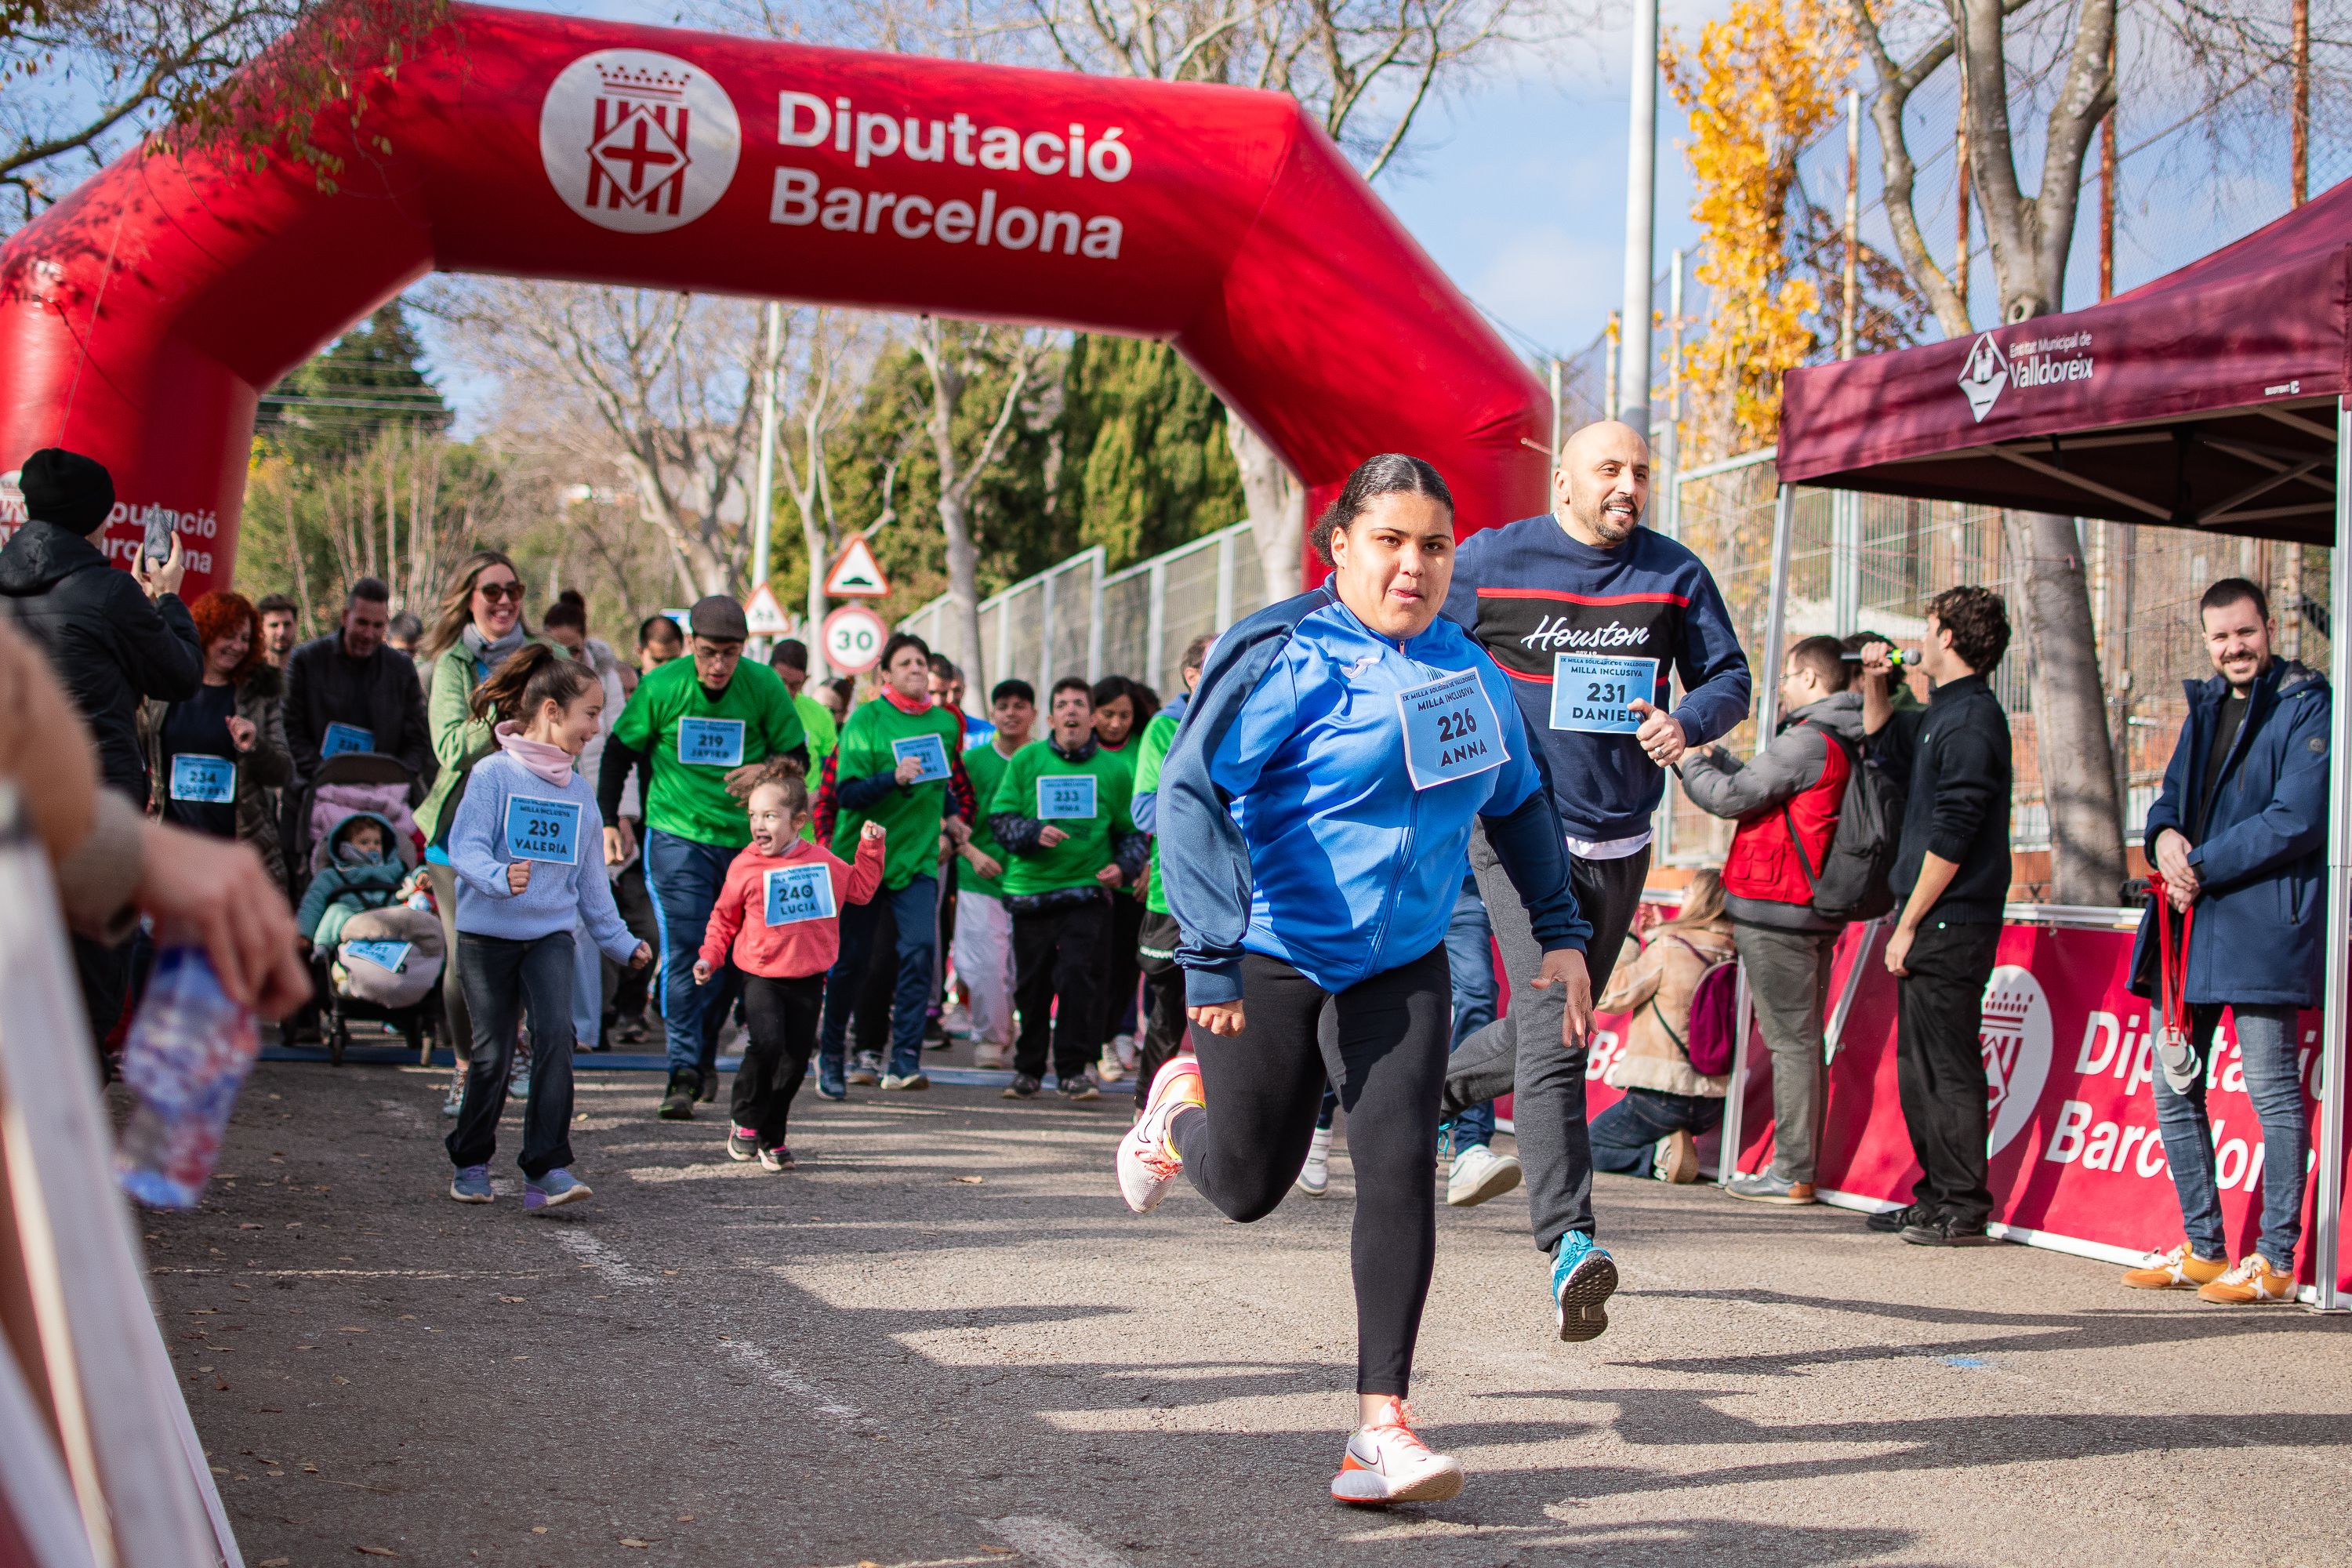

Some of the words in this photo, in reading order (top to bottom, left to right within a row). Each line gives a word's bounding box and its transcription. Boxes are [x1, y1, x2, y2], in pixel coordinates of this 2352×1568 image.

[777, 89, 1133, 183] Diputació
[769, 165, 1123, 260] Barcelona
[2038, 331, 2079, 353] Municipal
[2079, 331, 2092, 347] de
[2009, 352, 2093, 389] Valldoreix
[837, 630, 873, 651] 30
[1520, 614, 1650, 652] Houston
[1571, 666, 1597, 675] MILLA
[1600, 668, 1643, 677] INCLUSIVA
[1411, 690, 1429, 700] MILLA
[1417, 696, 1444, 711] MILLA
[1444, 686, 1475, 702] INCLUSIVA
[1586, 682, 1626, 704] 231
[1437, 708, 1477, 742] 226
[1572, 707, 1636, 723] DANIEL
[699, 733, 724, 746] 219
[1441, 739, 1488, 767] ANNA
[190, 771, 216, 783] 234
[1054, 790, 1080, 802] 233
[528, 819, 560, 838] 239
[515, 838, 568, 855] VALERIA
[778, 885, 814, 902] 240
